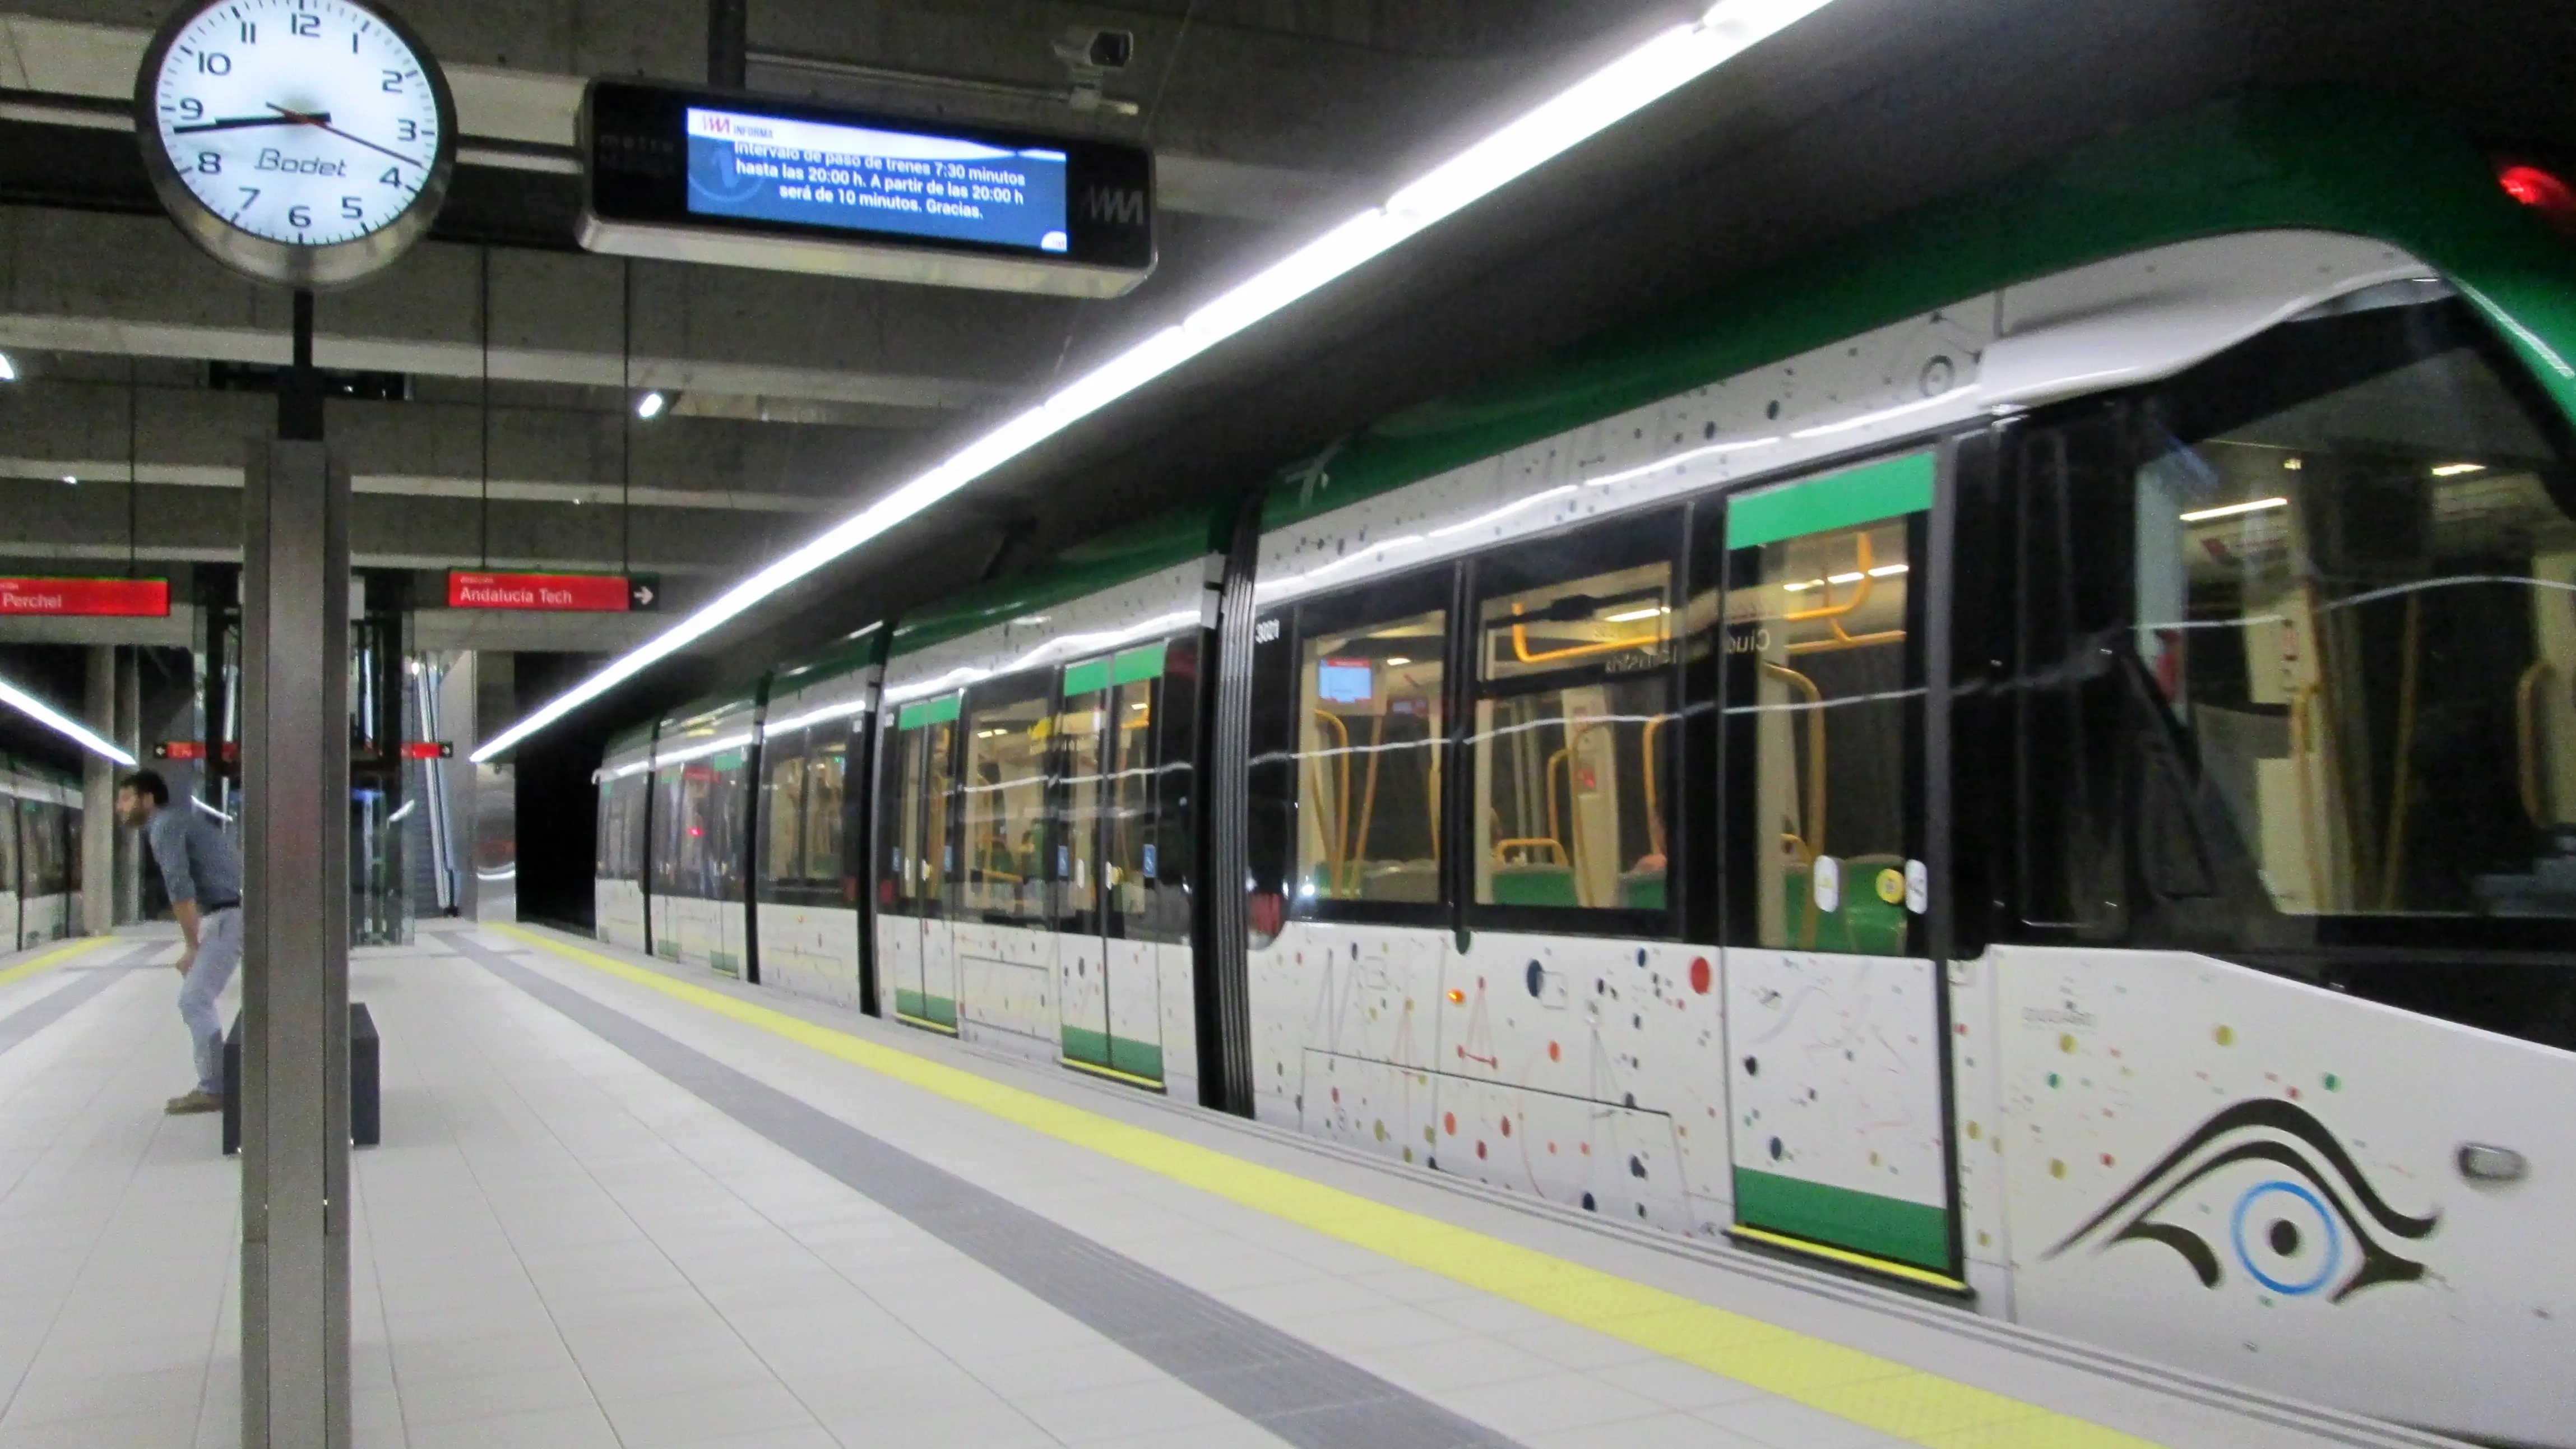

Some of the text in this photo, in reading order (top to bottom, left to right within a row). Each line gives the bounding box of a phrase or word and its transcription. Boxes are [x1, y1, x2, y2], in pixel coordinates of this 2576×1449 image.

[241, 22, 256, 45] 11
[291, 13, 321, 38] 12
[352, 32, 358, 54] 1
[197, 51, 231, 76] 10
[382, 70, 403, 94] 2
[180, 97, 204, 121] 9
[397, 119, 418, 142] 3
[733, 124, 773, 139] INFORMA
[198, 151, 221, 175] 8
[254, 148, 348, 177] Bodet
[734, 141, 1025, 186] Intervalo de paso de trenes 7:30 minutos
[379, 167, 401, 189] 4
[736, 158, 1023, 205] hasta las 20:00 h. A partir de las 20:00 h
[238, 187, 261, 211] 7
[341, 196, 363, 219] 5
[779, 184, 984, 219] será de 10 minutos. Gracias.
[289, 205, 311, 229] 6
[2, 592, 62, 609] Perchel
[460, 586, 572, 604] Andalucía Tech
